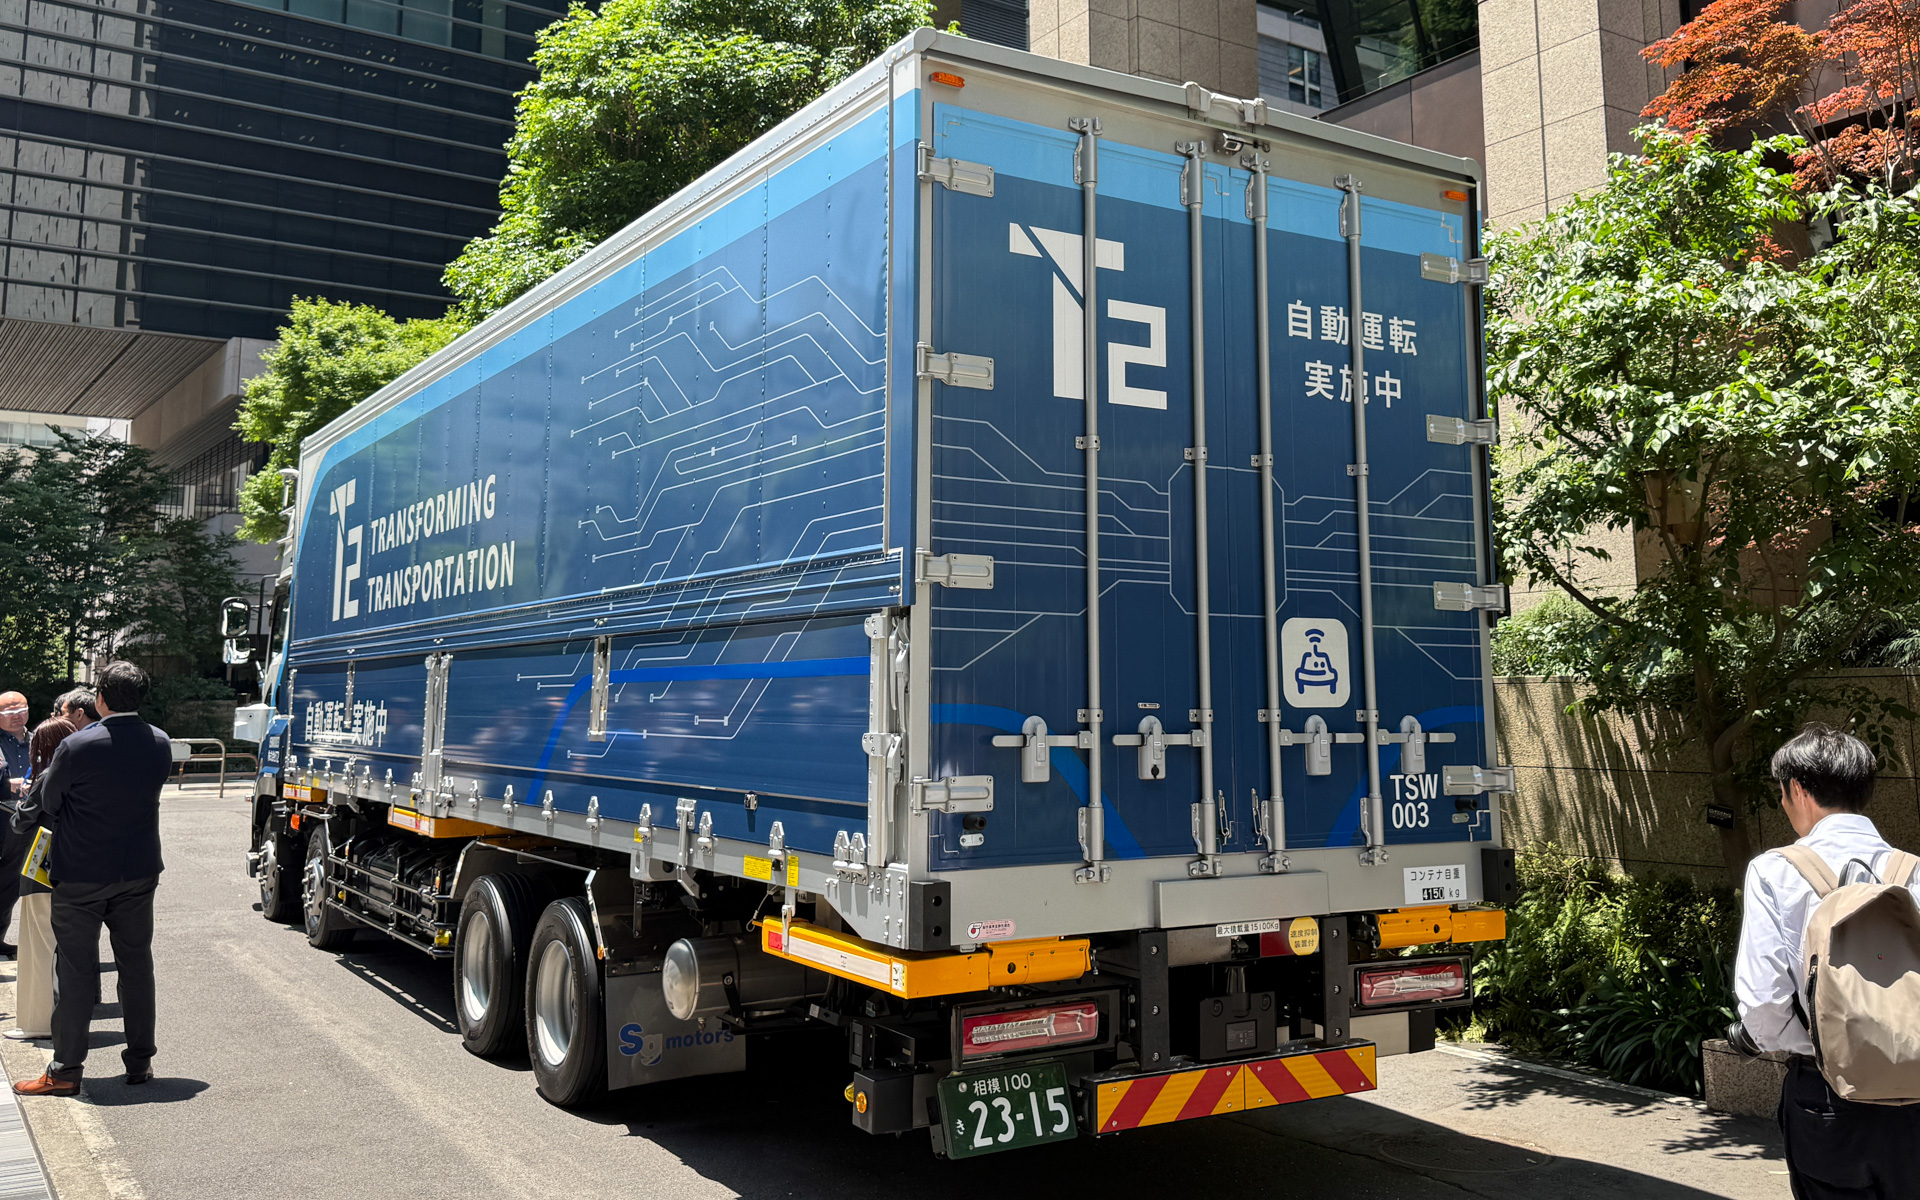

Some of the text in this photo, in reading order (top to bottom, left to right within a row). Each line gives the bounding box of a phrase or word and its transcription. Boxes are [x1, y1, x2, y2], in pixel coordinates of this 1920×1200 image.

[1009, 222, 1168, 411] T2
[1287, 299, 1418, 357] 自動運転
[1304, 359, 1402, 409] 実施中
[371, 473, 497, 556] TRANSFORMING
[366, 540, 516, 614] TRANSPORTATION
[1389, 773, 1439, 801] TSW
[1391, 801, 1431, 829] 003
[1410, 867, 1461, 881] コンテナ自重
[1422, 887, 1445, 901] 4150
[1290, 928, 1318, 939] 速度抑制
[1294, 939, 1315, 949] 装置付
[956, 1086, 1070, 1148] き 23-15
